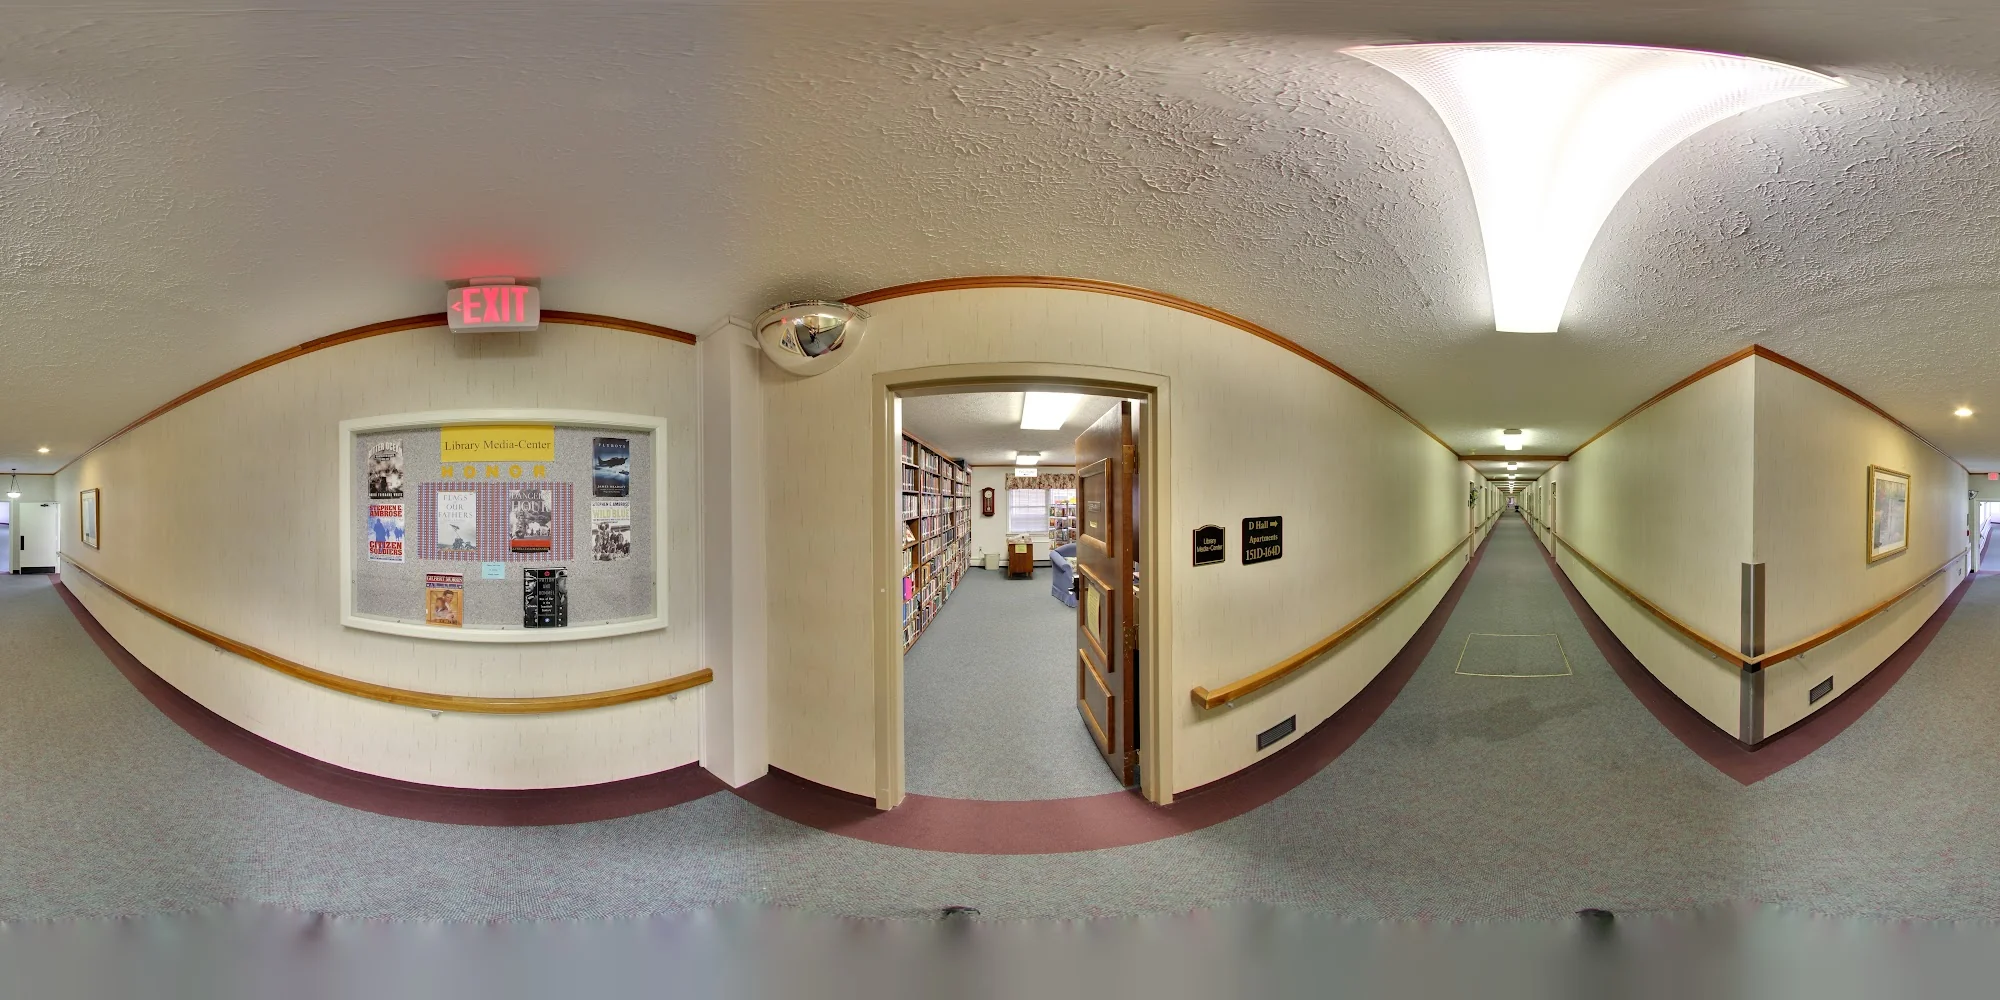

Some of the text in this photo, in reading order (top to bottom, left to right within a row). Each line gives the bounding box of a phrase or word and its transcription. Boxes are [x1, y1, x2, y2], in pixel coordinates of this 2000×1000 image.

[462, 287, 529, 324] EXIT
[444, 439, 551, 452] Library Media-Center
[511, 492, 550, 500] DANGER
[446, 503, 464, 511] OUR
[511, 500, 551, 512] HOUR
[369, 510, 402, 518] AMBROSE
[438, 511, 473, 519] FATHERS
[592, 509, 629, 519] WILD BLUE
[1248, 520, 1269, 531] D Hall
[1248, 534, 1279, 545] Apartments
[369, 540, 402, 550] CITIZEN
[369, 548, 402, 556] SOLDIERS
[1245, 545, 1281, 561] 151D-164D
